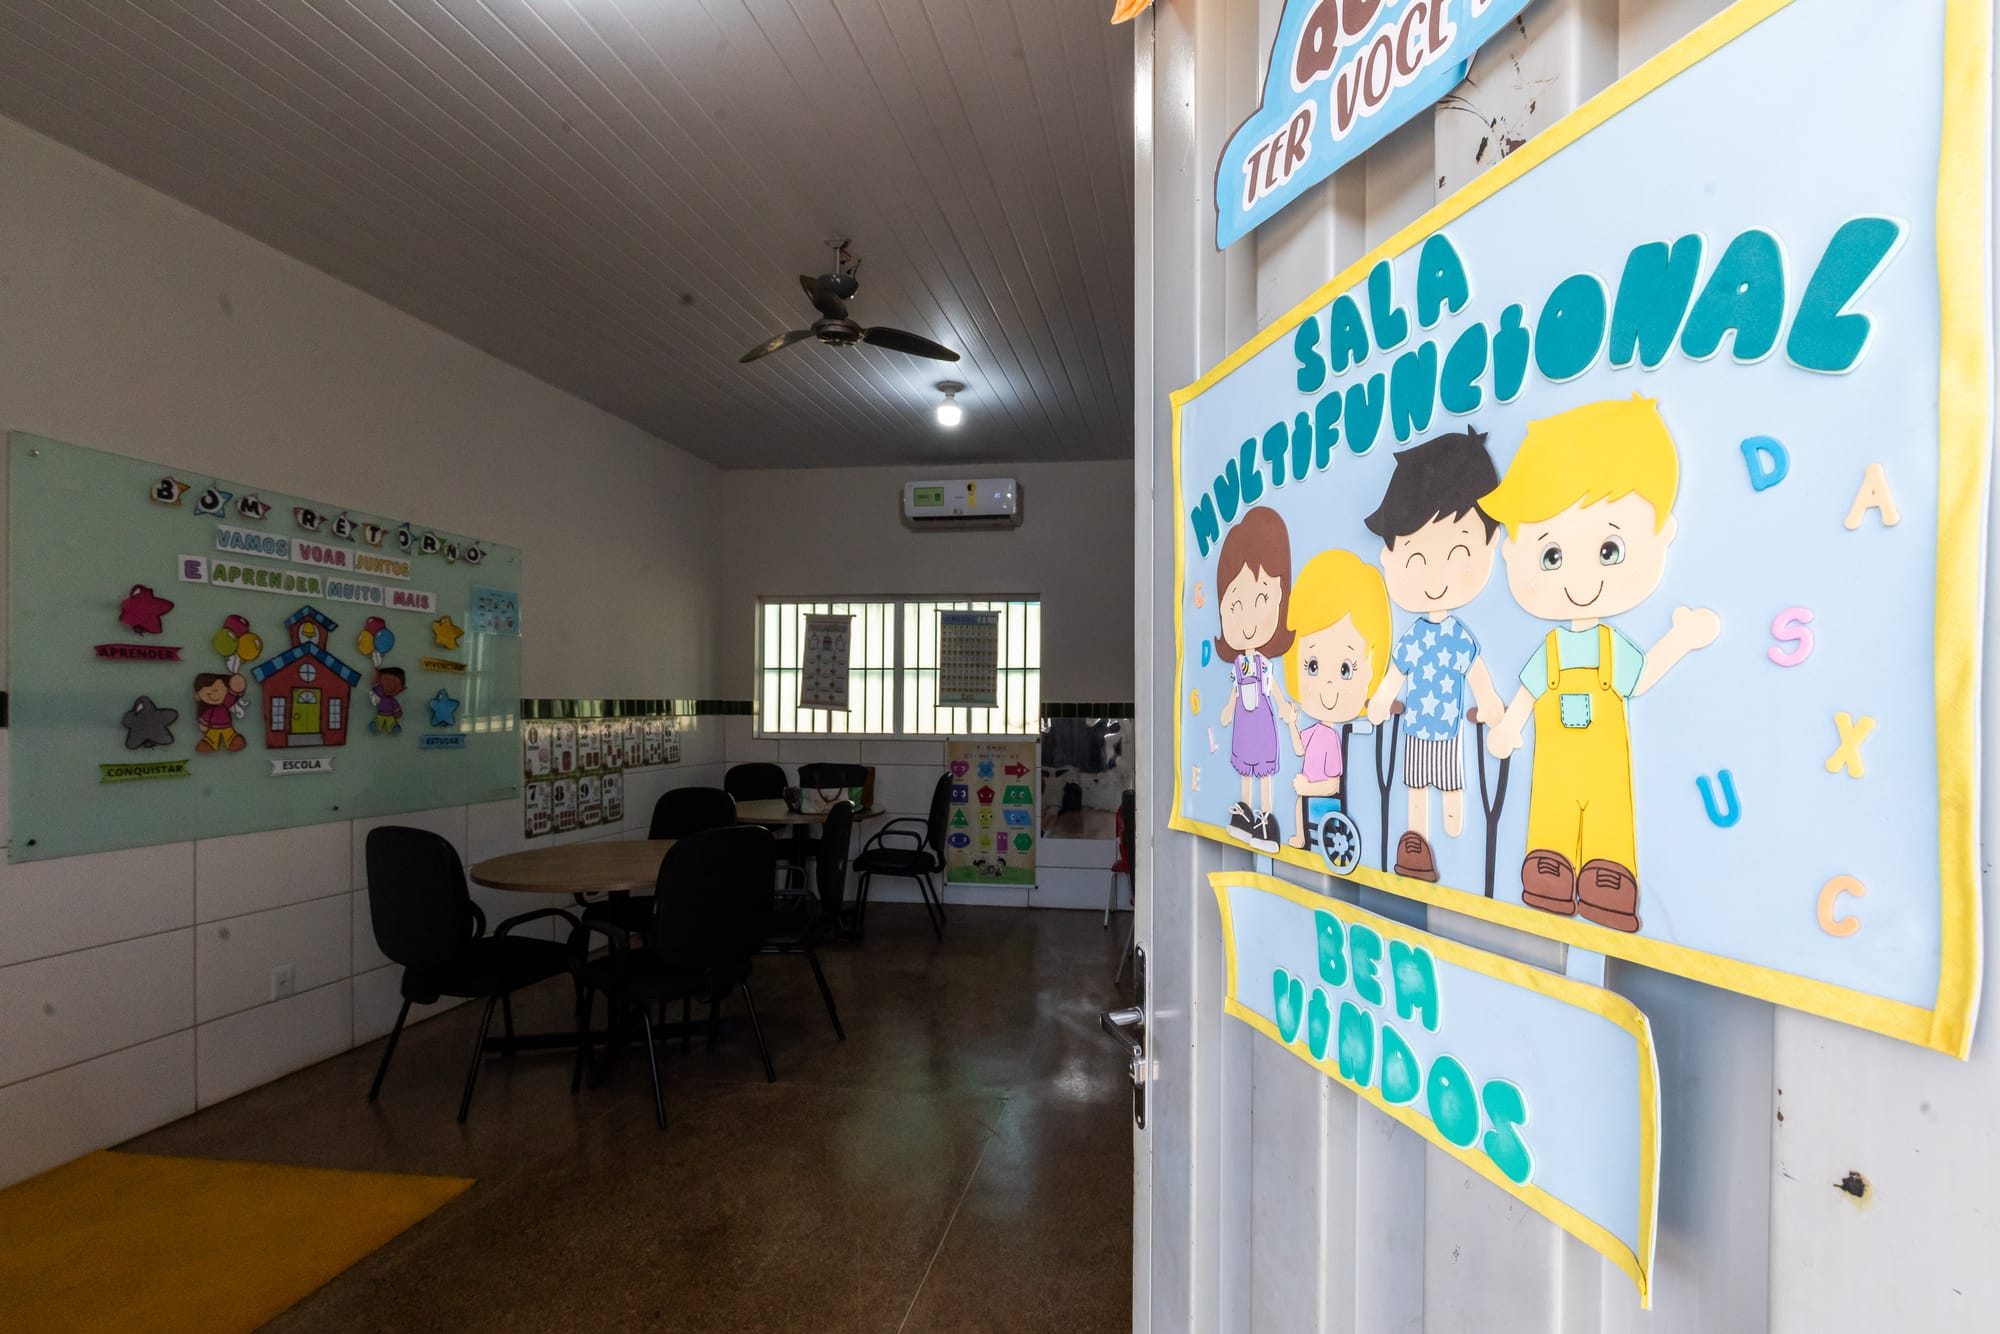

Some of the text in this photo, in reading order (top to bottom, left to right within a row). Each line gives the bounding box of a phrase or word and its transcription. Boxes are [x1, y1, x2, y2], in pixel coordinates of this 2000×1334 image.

[1248, 108, 1311, 204] TER
[1295, 233, 1471, 394] SALA
[1191, 216, 1909, 559] MULTIFUNCIONAL
[1741, 437, 1790, 492] D
[1845, 464, 1901, 531] A
[218, 530, 410, 578] VAMOS VOAR JUNTOS
[184, 560, 430, 610] E APRENDER MUITO MAIS
[98, 645, 174, 660] APRENDER
[1201, 640, 1211, 667] D
[1767, 607, 1815, 668] S
[107, 764, 183, 777] CONQUISTAR
[283, 759, 322, 770] ESCOLA
[1826, 711, 1875, 779] X
[528, 785, 537, 801] 7
[556, 786, 564, 801] 8
[581, 784, 589, 799] 9
[604, 778, 614, 788] 10
[1191, 766, 1201, 791] E
[1695, 768, 1743, 828] U
[1816, 876, 1867, 937] C
[1315, 910, 1443, 1034] BEM
[1274, 968, 1536, 1186] VINDOS
